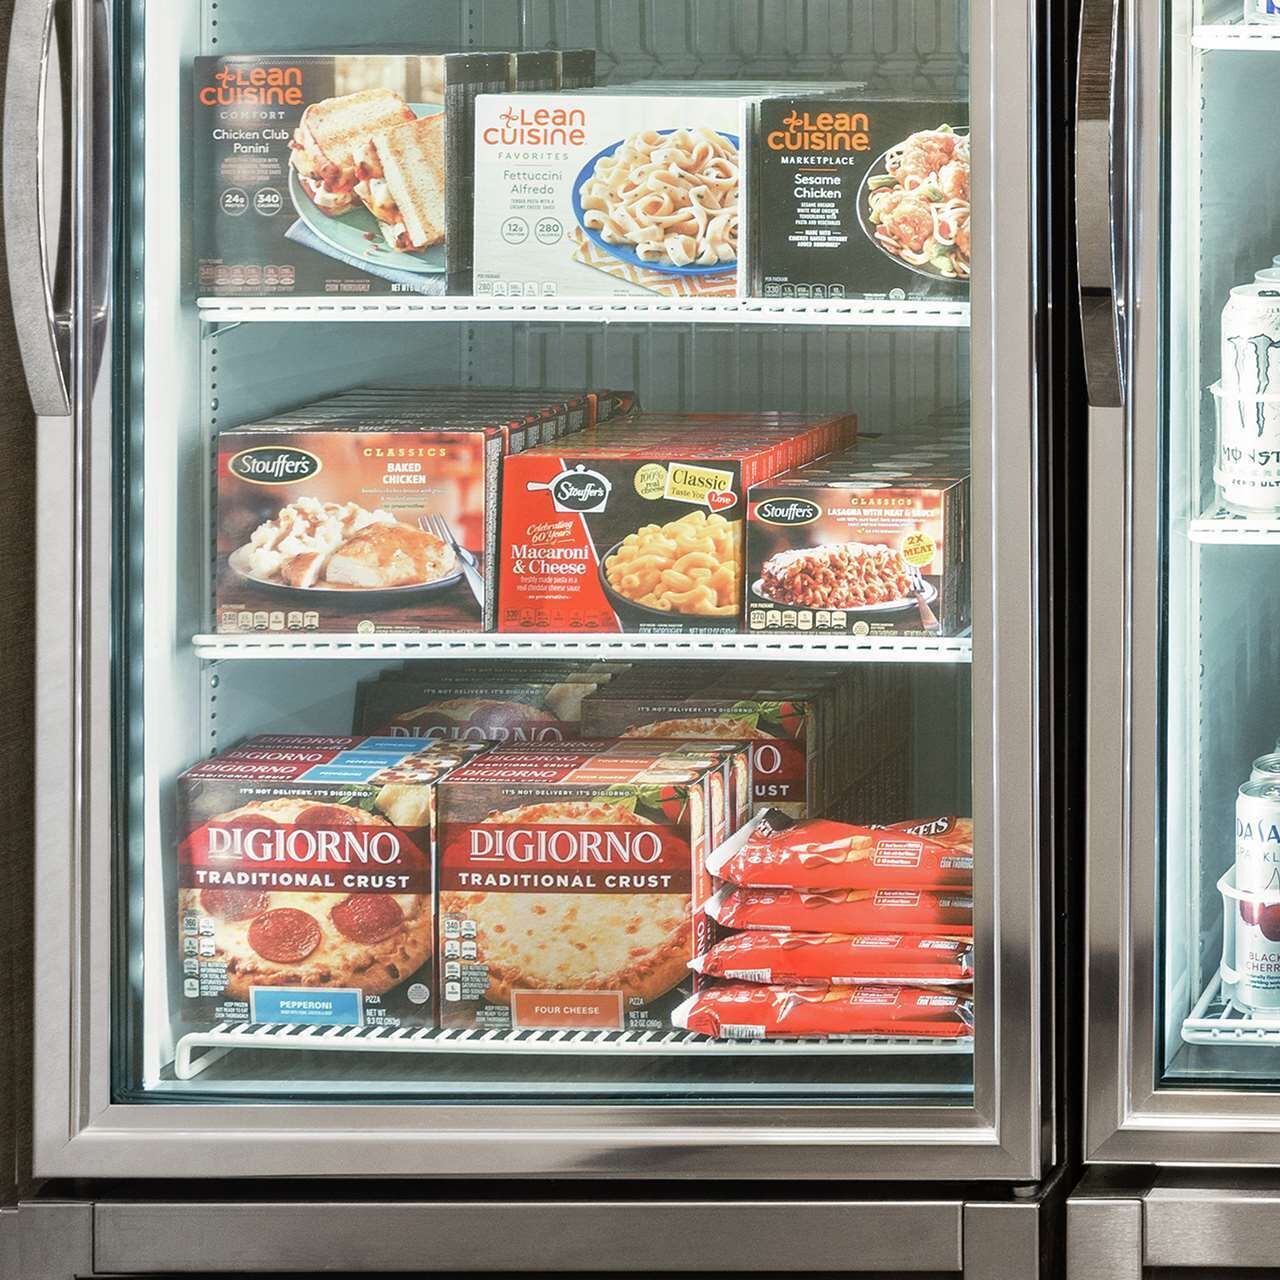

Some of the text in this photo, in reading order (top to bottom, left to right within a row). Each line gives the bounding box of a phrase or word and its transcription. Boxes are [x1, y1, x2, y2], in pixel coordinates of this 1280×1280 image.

[213, 129, 289, 140] Chicken Club
[234, 143, 269, 153] Panini
[498, 152, 568, 160] FAVORITES
[781, 157, 855, 165] MARKETPLACE
[504, 170, 562, 181] Fettuccini
[795, 174, 841, 185] Sesame
[511, 184, 554, 194] Alfredo
[794, 188, 841, 199] Chicken
[258, 195, 279, 203] 340
[539, 224, 559, 232] 280
[364, 448, 447, 457] CLASSICS
[240, 455, 310, 475] Stouffer's
[388, 463, 422, 473] BAKED
[382, 474, 426, 484] CHICKEN
[673, 470, 726, 490] Classic
[558, 482, 604, 501] Stouffer's
[762, 504, 813, 520] Stouffer's
[511, 545, 589, 559] Macaroni
[903, 545, 932, 557] MEAT
[513, 560, 586, 574] & Cheese
[208, 828, 400, 864] DIGIORNO
[470, 830, 662, 863] DIGIORNO
[197, 871, 410, 888] TRADITIONAL CRUST
[459, 873, 672, 888] TRADITIONAL CRUST
[280, 1001, 332, 1010] PEPPERONI
[535, 1006, 600, 1015] FOUR CHEESE
